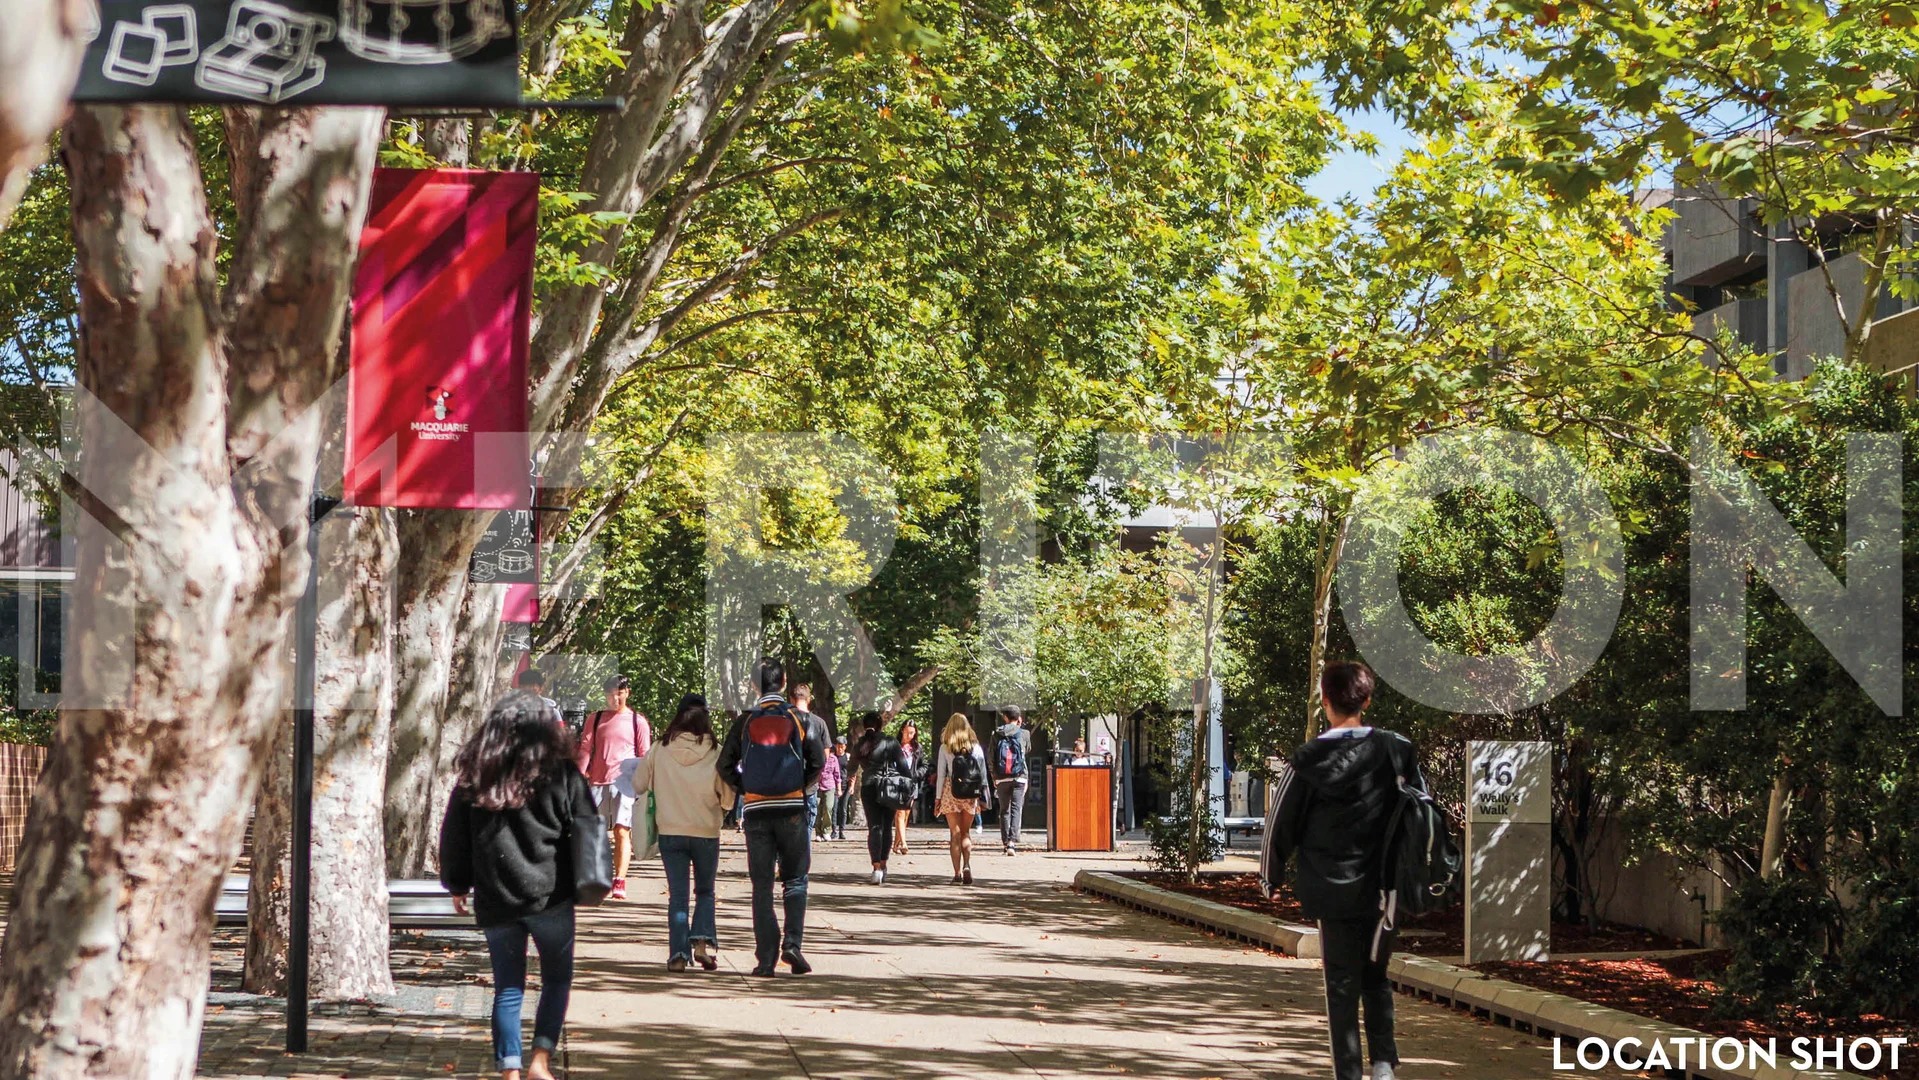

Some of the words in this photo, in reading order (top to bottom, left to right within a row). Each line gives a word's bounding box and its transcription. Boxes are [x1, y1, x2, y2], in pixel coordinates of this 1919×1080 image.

[411, 422, 469, 432] MACQUARIE
[418, 432, 460, 441] University
[1480, 761, 1512, 786] 16
[1480, 793, 1519, 805] Wally's
[1480, 805, 1508, 815] Walk
